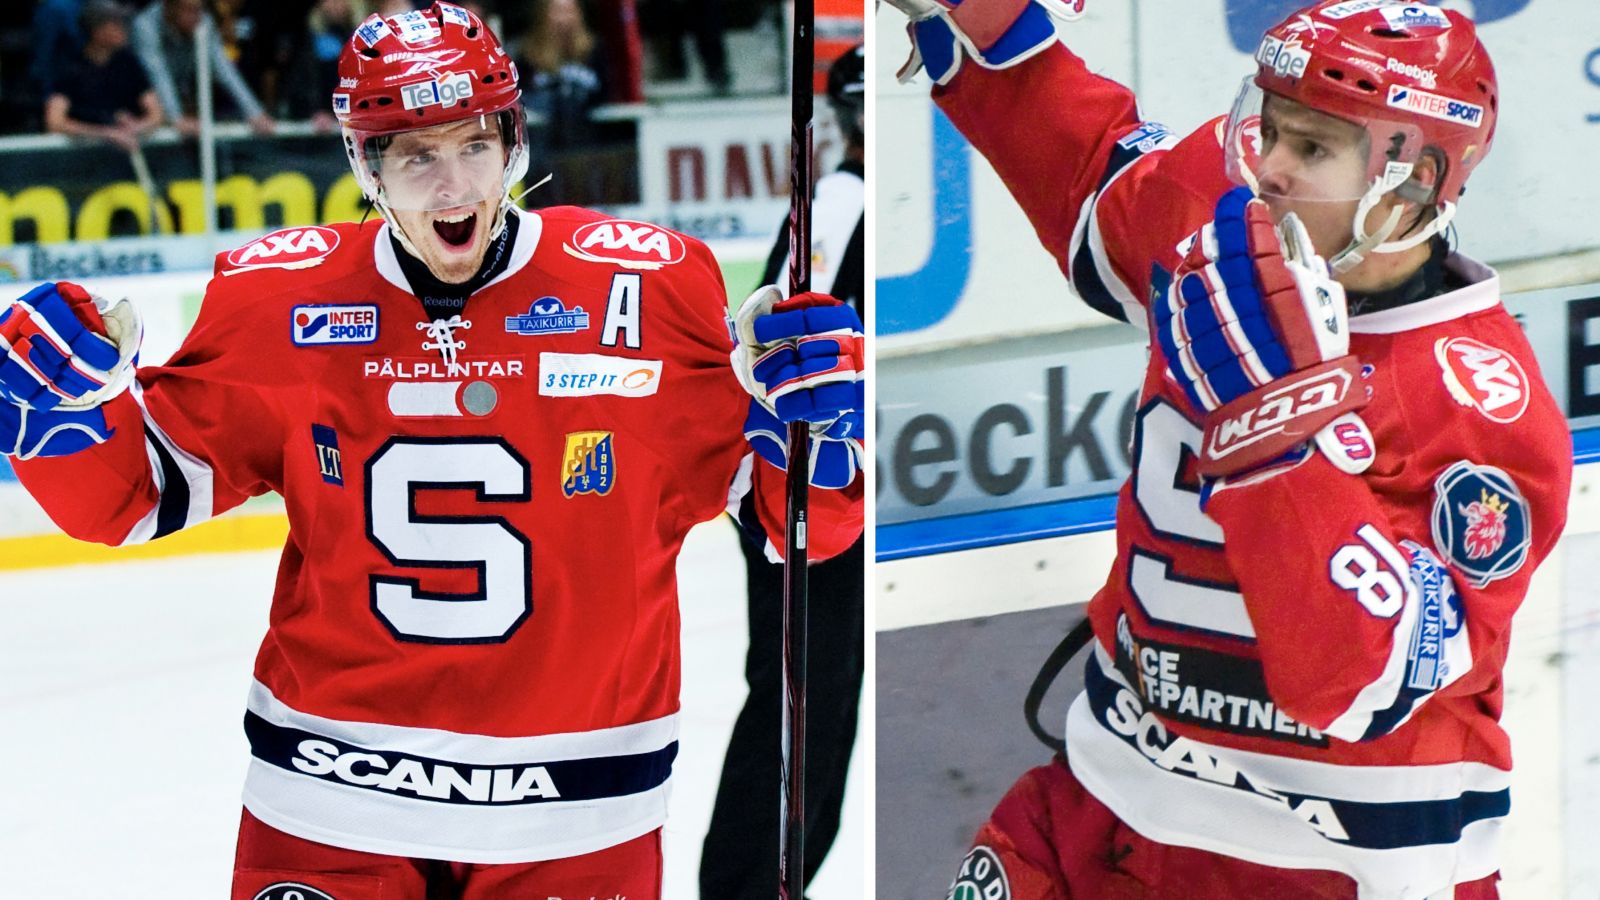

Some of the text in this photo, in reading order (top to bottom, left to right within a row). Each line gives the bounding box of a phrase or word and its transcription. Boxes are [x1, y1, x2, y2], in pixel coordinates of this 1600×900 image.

[1261, 37, 1305, 76] Telge
[1387, 58, 1438, 83] Reebok
[402, 80, 470, 107] Telge
[237, 228, 330, 264] AXA
[580, 223, 671, 261] AXA
[329, 311, 374, 325] INTER
[520, 316, 574, 329] TAXIKURIR
[600, 272, 642, 350] A
[329, 325, 374, 339] SPORT
[364, 358, 523, 378] PÅLPLINTAR
[545, 373, 618, 389] 3 STEP IT
[1450, 343, 1521, 412] AXA
[875, 366, 1138, 506] eck
[1334, 423, 1373, 461] S
[364, 435, 534, 644] S
[291, 738, 561, 802] SCANIA
[1106, 688, 1350, 841] SCANA
